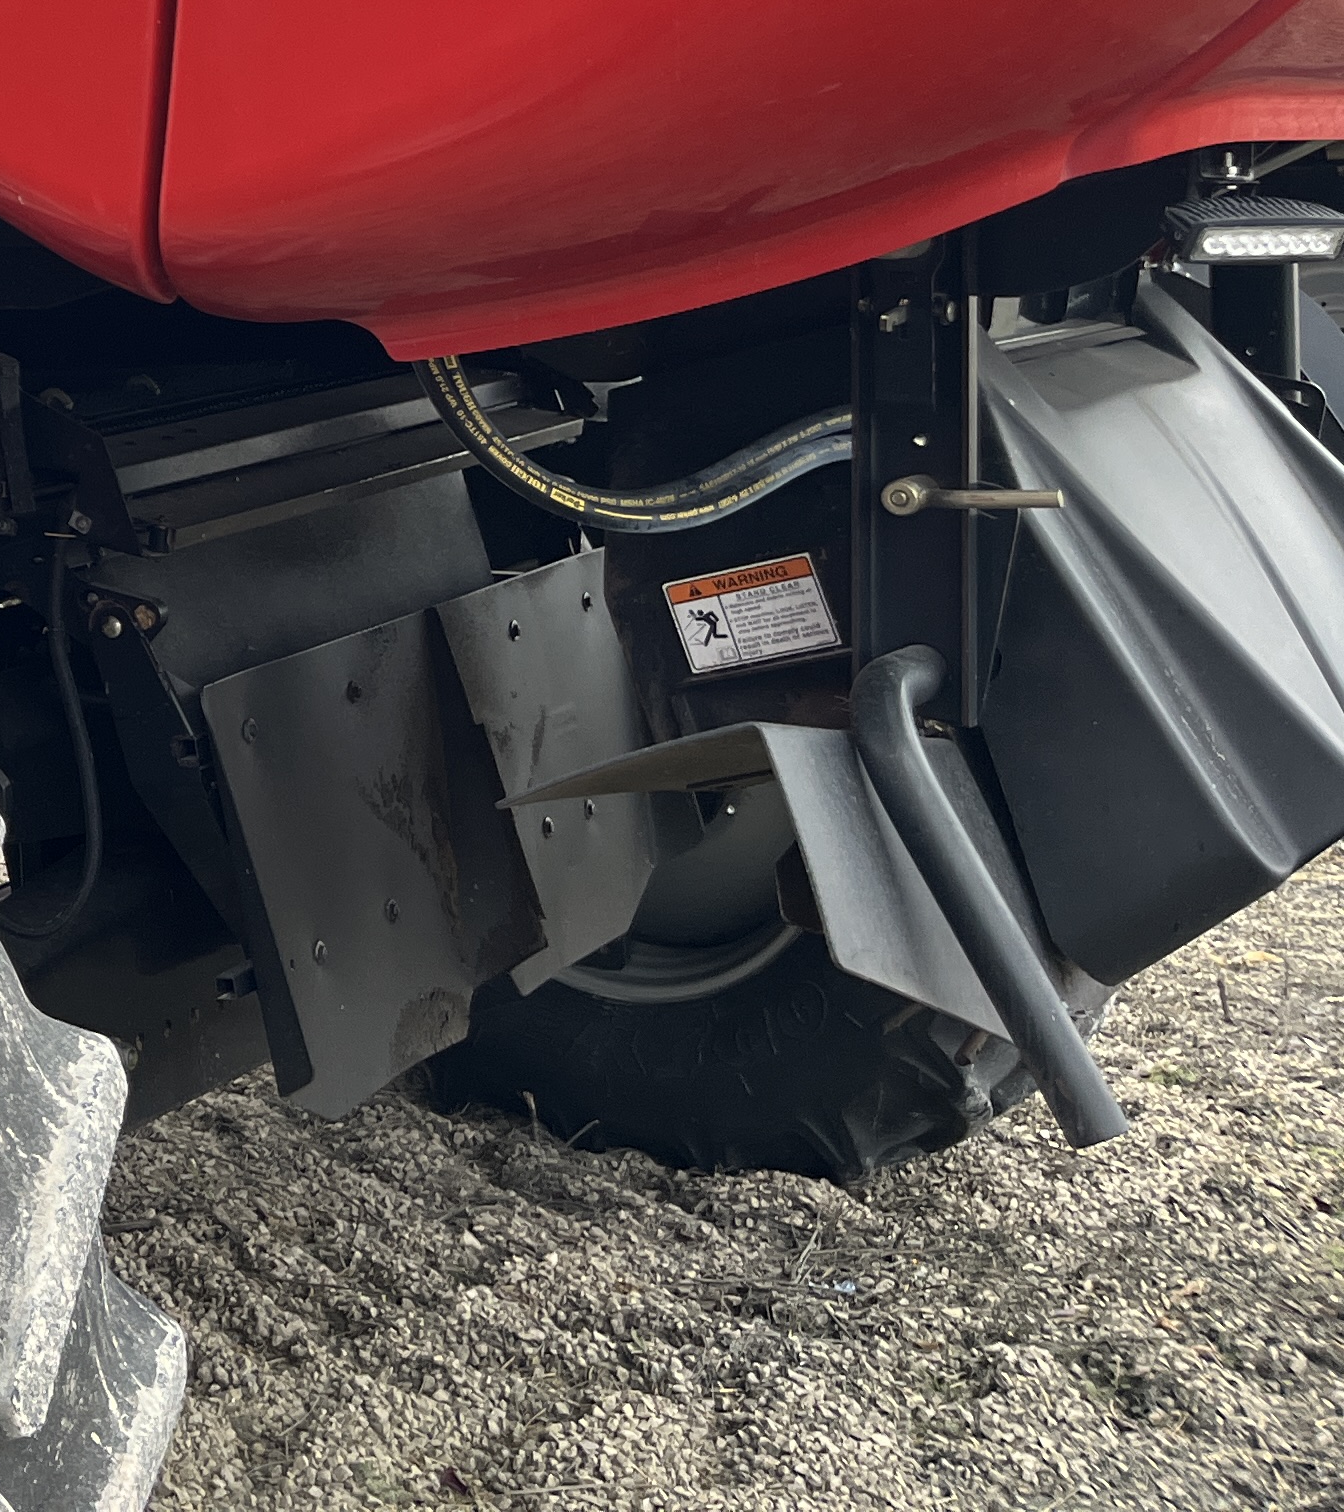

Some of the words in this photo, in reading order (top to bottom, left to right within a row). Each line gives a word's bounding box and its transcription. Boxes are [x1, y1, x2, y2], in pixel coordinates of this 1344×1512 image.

[553, 490, 580, 508] Parker
[713, 565, 789, 591] WARNING
[768, 580, 800, 594] CLEAR
